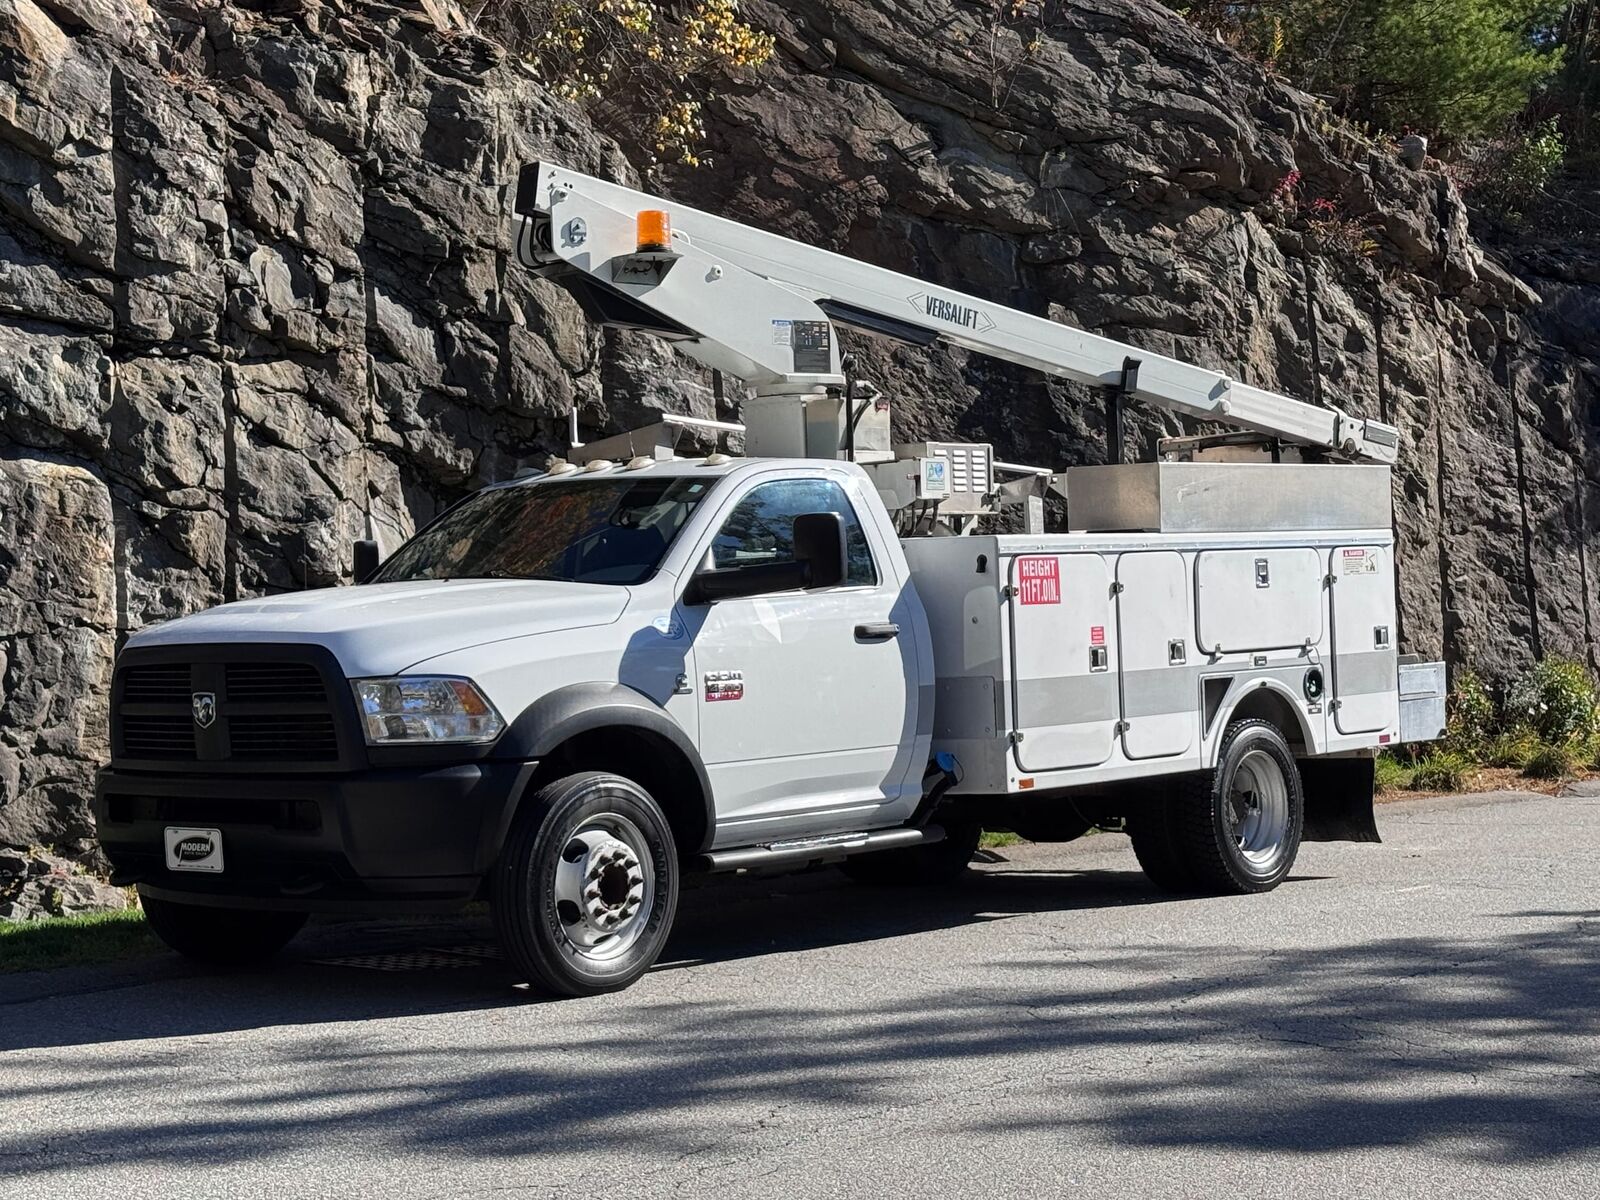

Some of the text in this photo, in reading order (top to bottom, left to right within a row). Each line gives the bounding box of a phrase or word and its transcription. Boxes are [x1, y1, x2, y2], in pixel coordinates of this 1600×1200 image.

[926, 295, 979, 330] VERSALIFT
[1022, 560, 1056, 577] HEIGHT
[180, 841, 211, 852] MODERN
